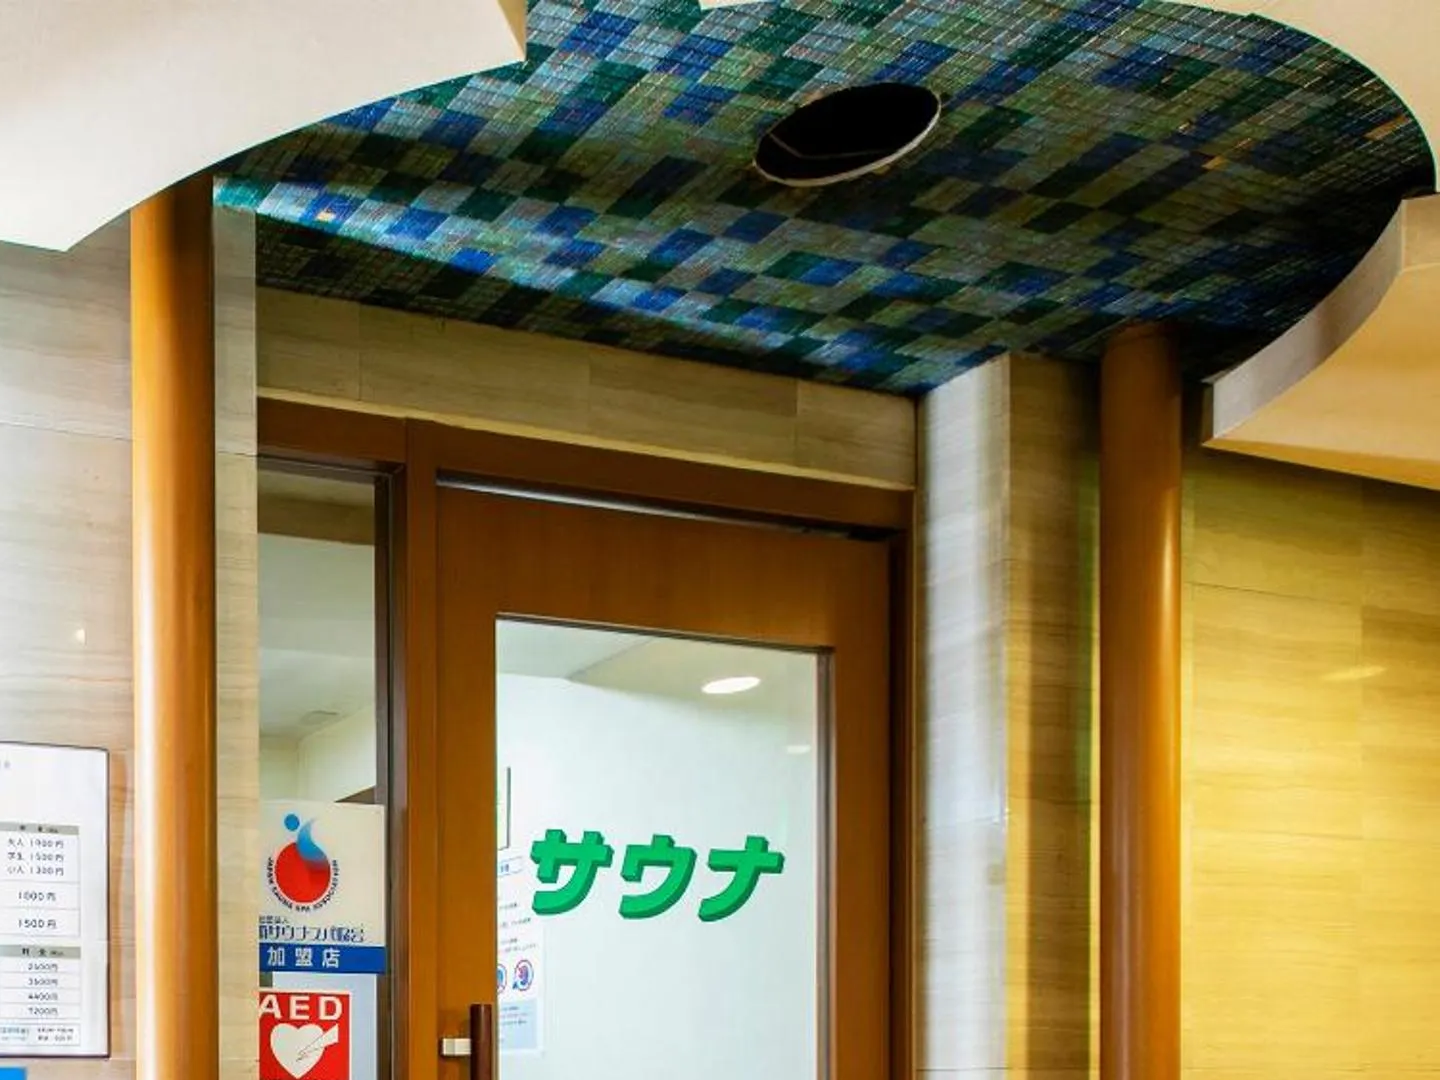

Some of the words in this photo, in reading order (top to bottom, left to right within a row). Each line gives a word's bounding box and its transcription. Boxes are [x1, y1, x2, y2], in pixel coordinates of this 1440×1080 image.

[530, 829, 785, 922] サウナ
[267, 947, 341, 968] 加盟店
[259, 995, 343, 1022] AED
